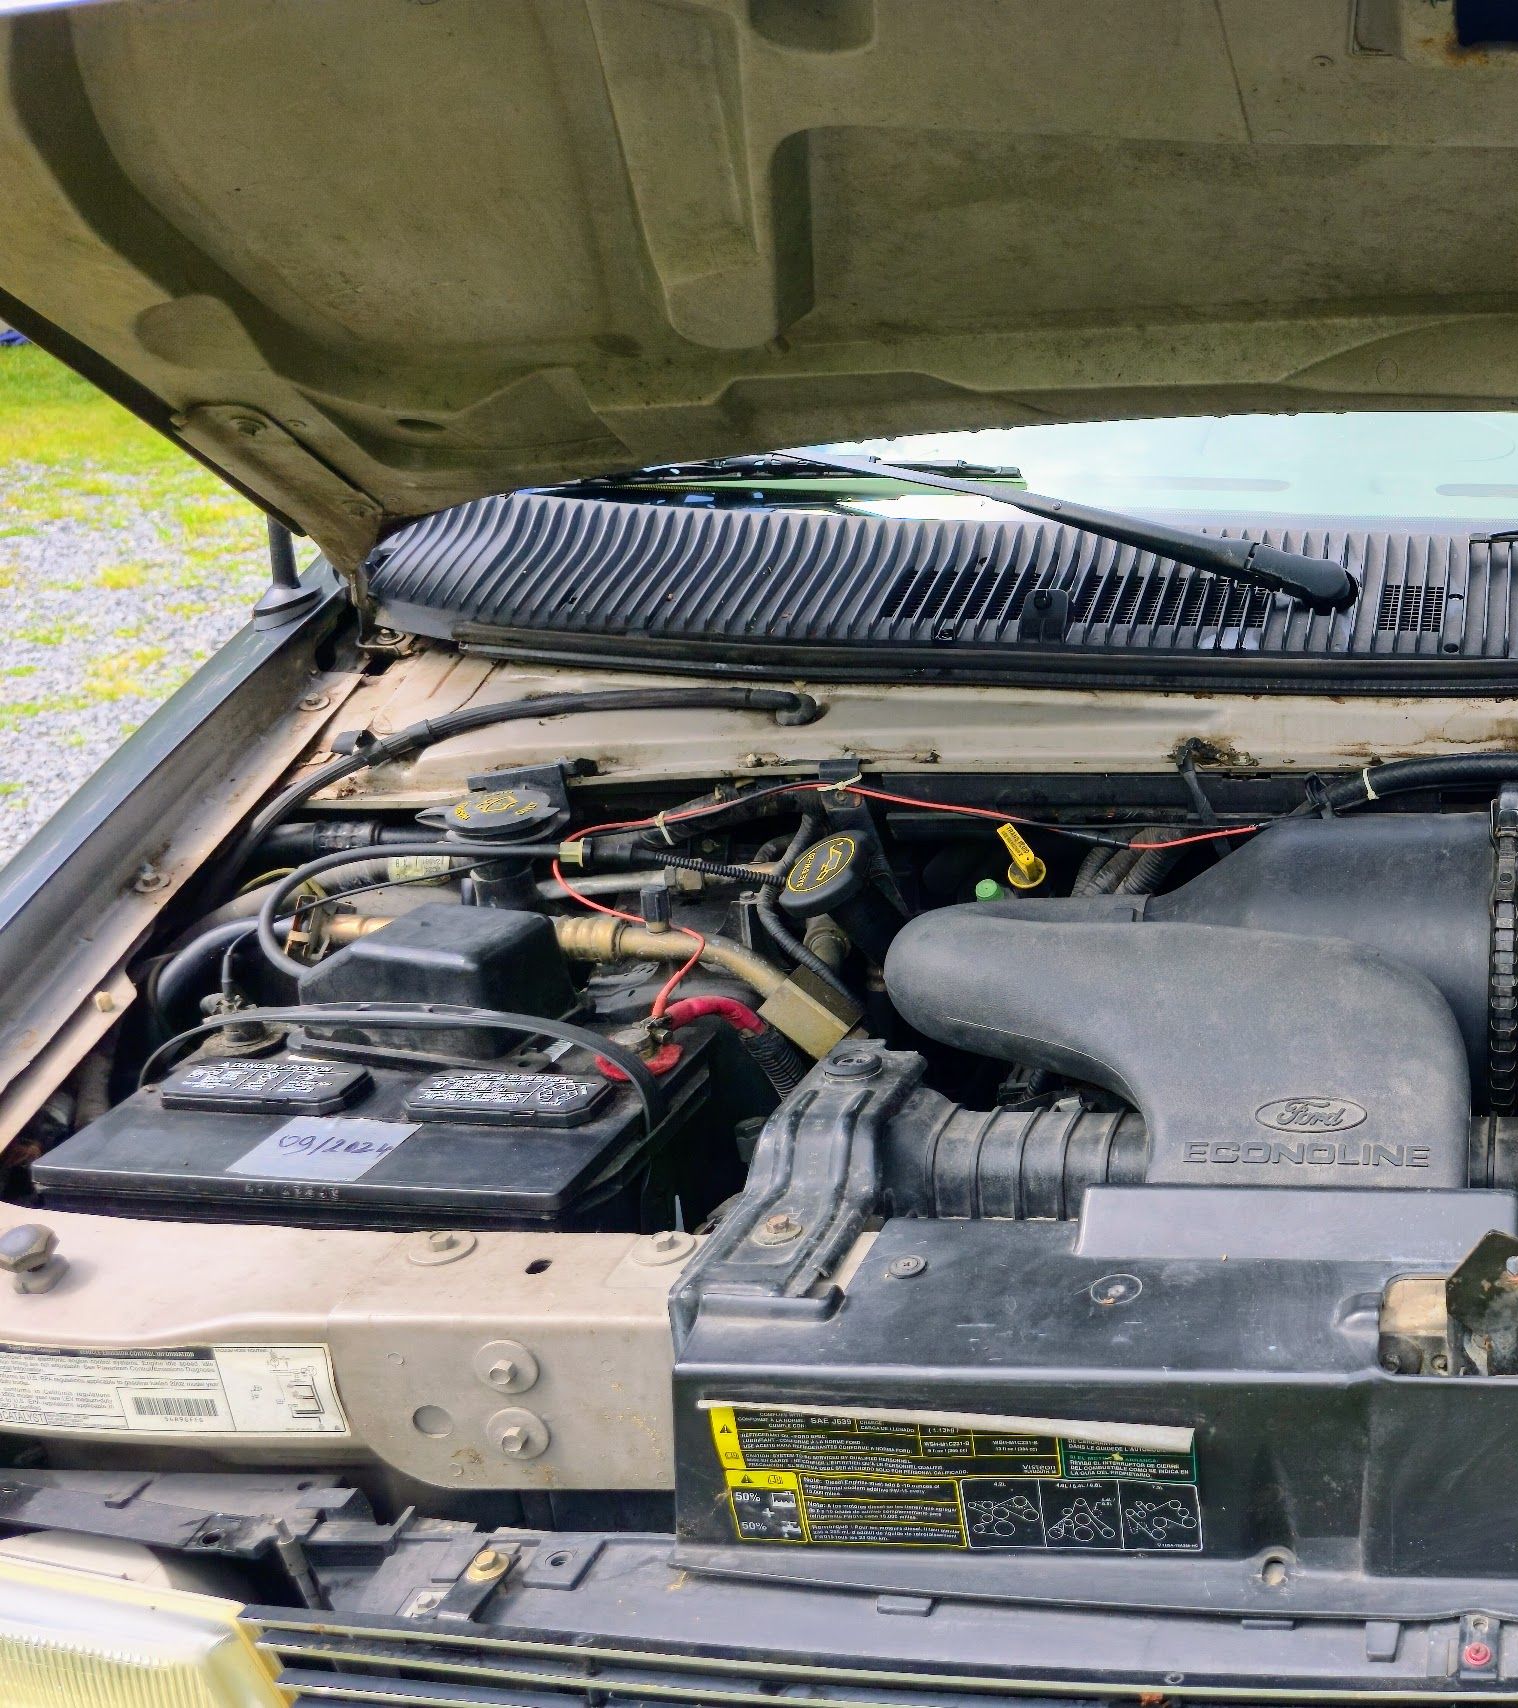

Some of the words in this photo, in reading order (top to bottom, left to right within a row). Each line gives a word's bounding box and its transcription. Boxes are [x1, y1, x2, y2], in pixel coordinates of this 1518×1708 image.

[1275, 1100, 1347, 1126] Ford
[278, 1134, 393, 1158] 09/2024
[1182, 1141, 1430, 1167] ECONOLINE
[736, 1492, 760, 1501] 50%
[741, 1521, 767, 1531] 50%
